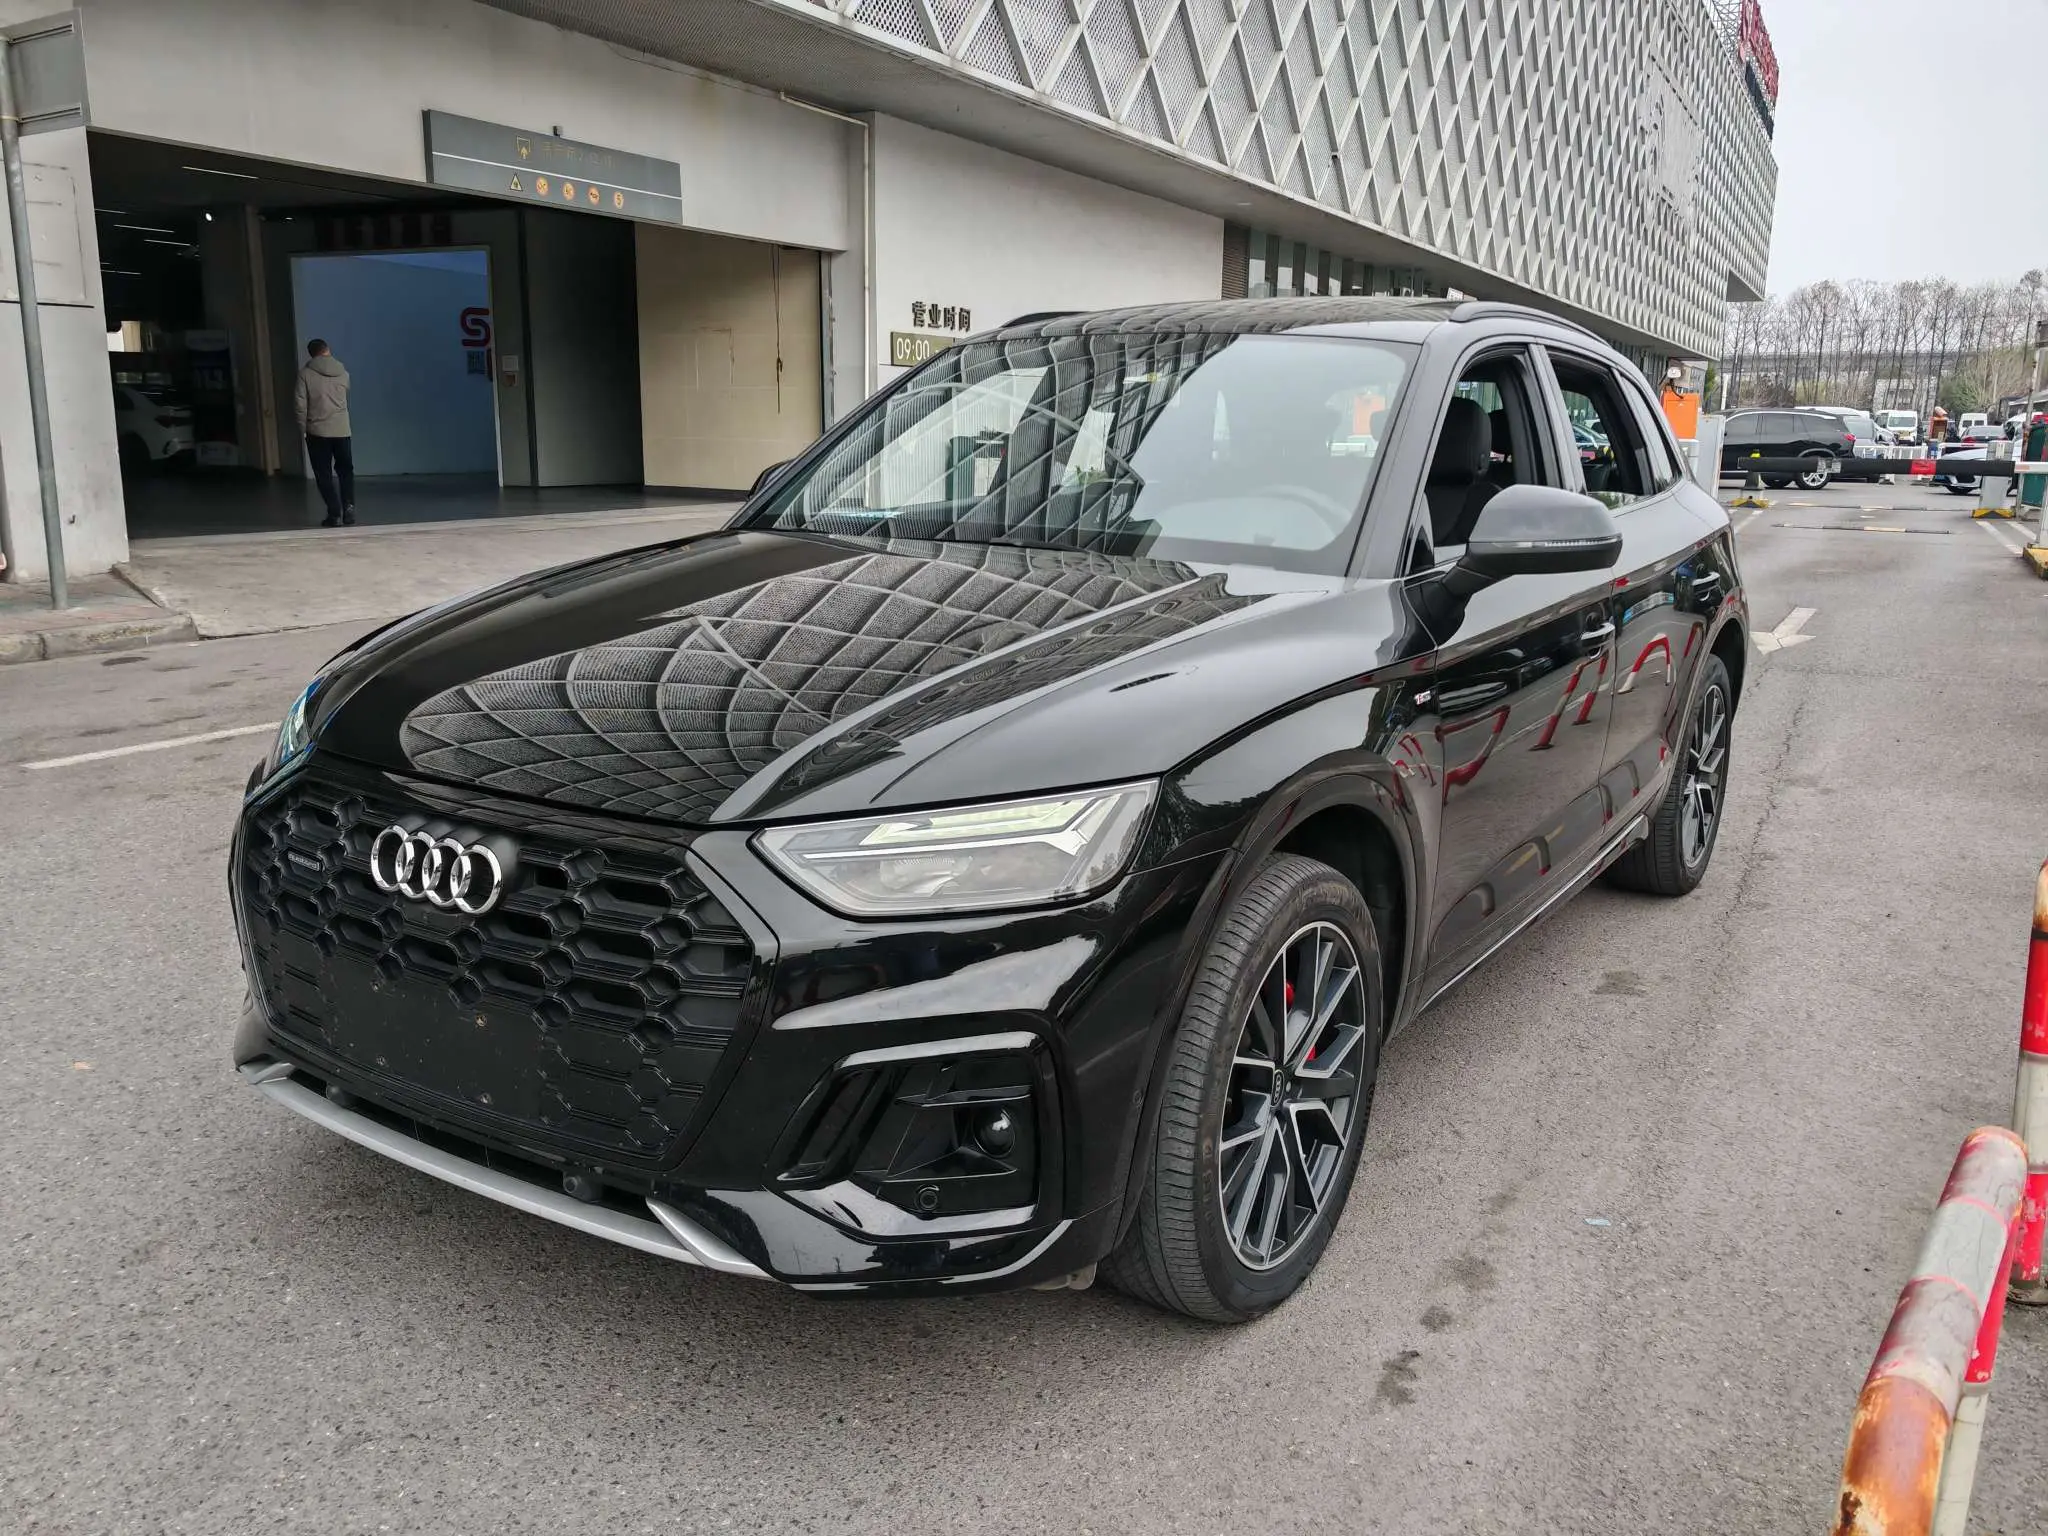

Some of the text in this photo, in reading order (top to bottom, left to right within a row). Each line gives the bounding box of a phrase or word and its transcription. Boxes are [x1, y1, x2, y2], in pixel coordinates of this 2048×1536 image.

[912, 301, 971, 332] 营业时间
[896, 338, 930, 361] 09:00
